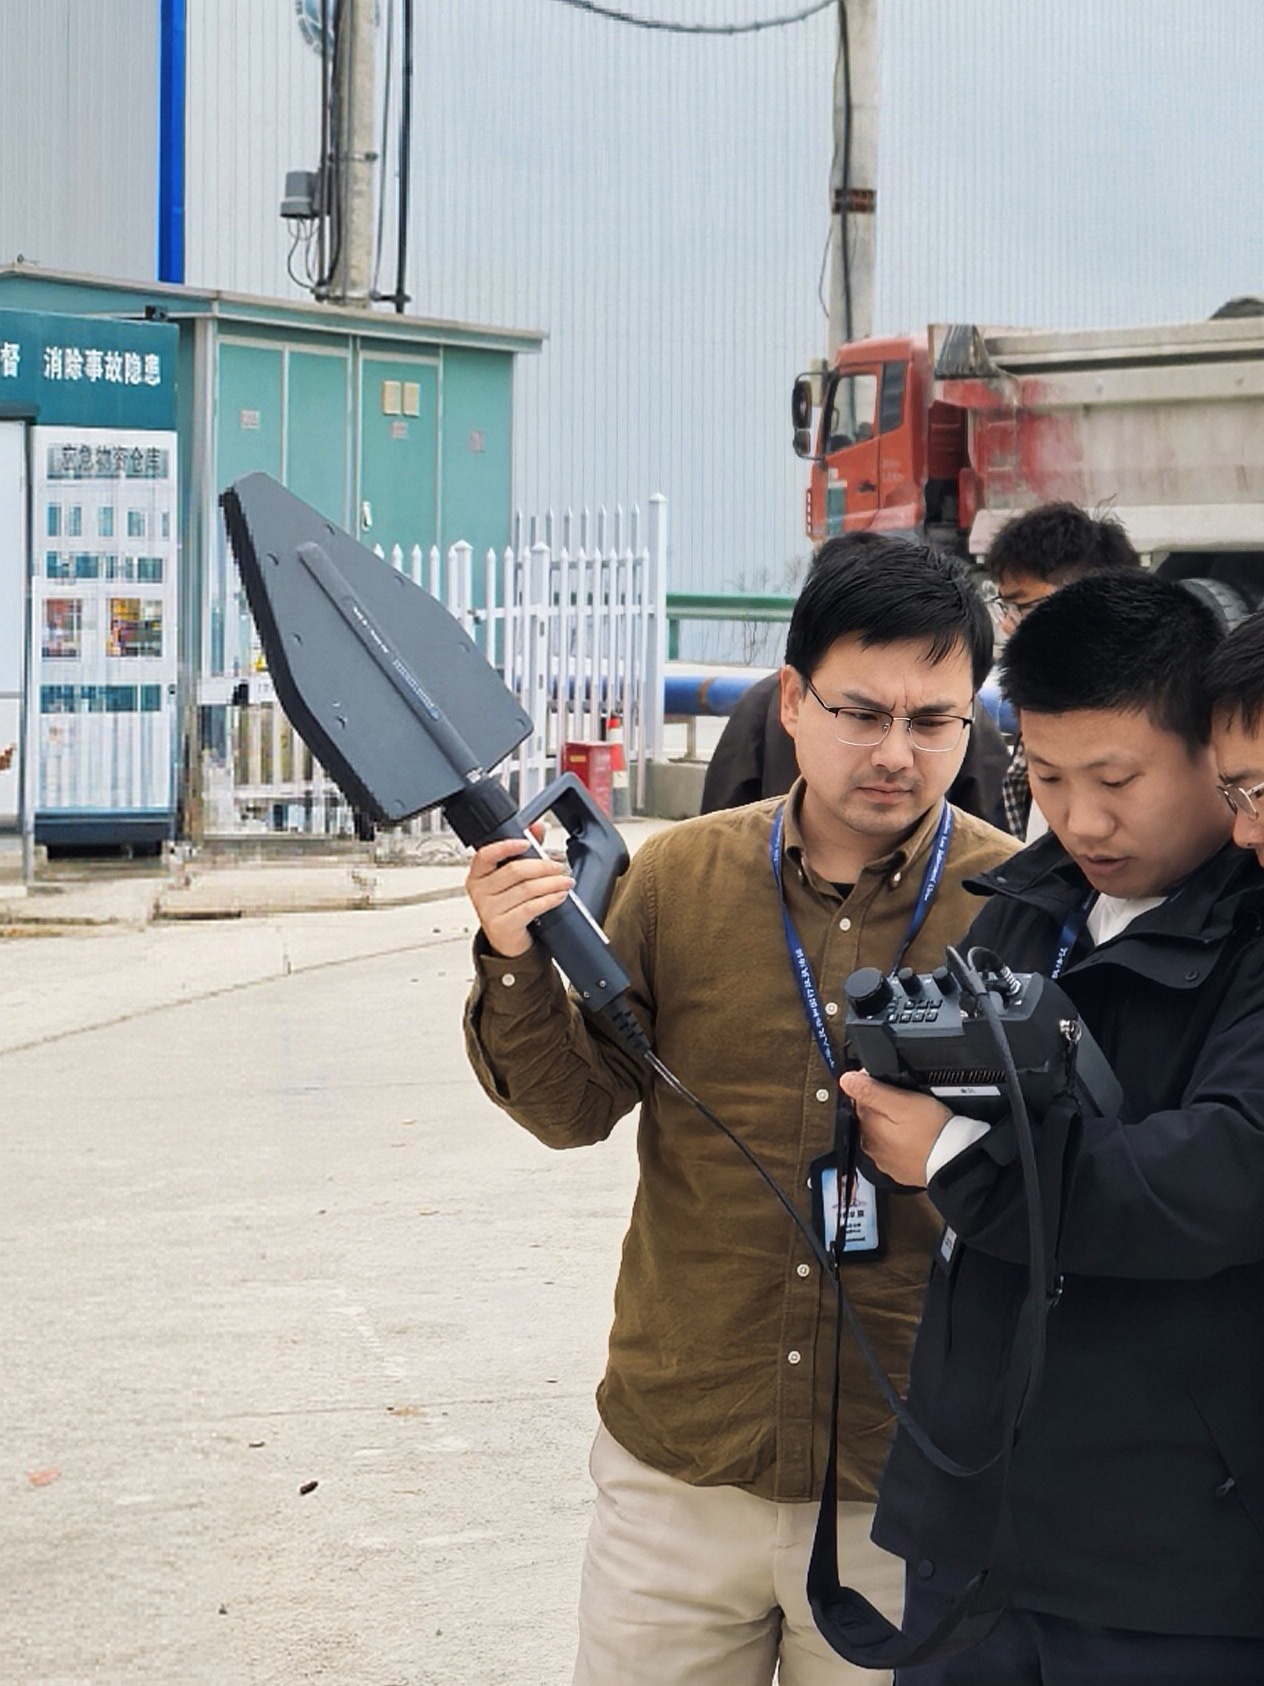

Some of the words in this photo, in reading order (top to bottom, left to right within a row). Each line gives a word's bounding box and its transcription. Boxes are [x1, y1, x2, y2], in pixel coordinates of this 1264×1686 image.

[43, 346, 161, 386] 消除事故隐患
